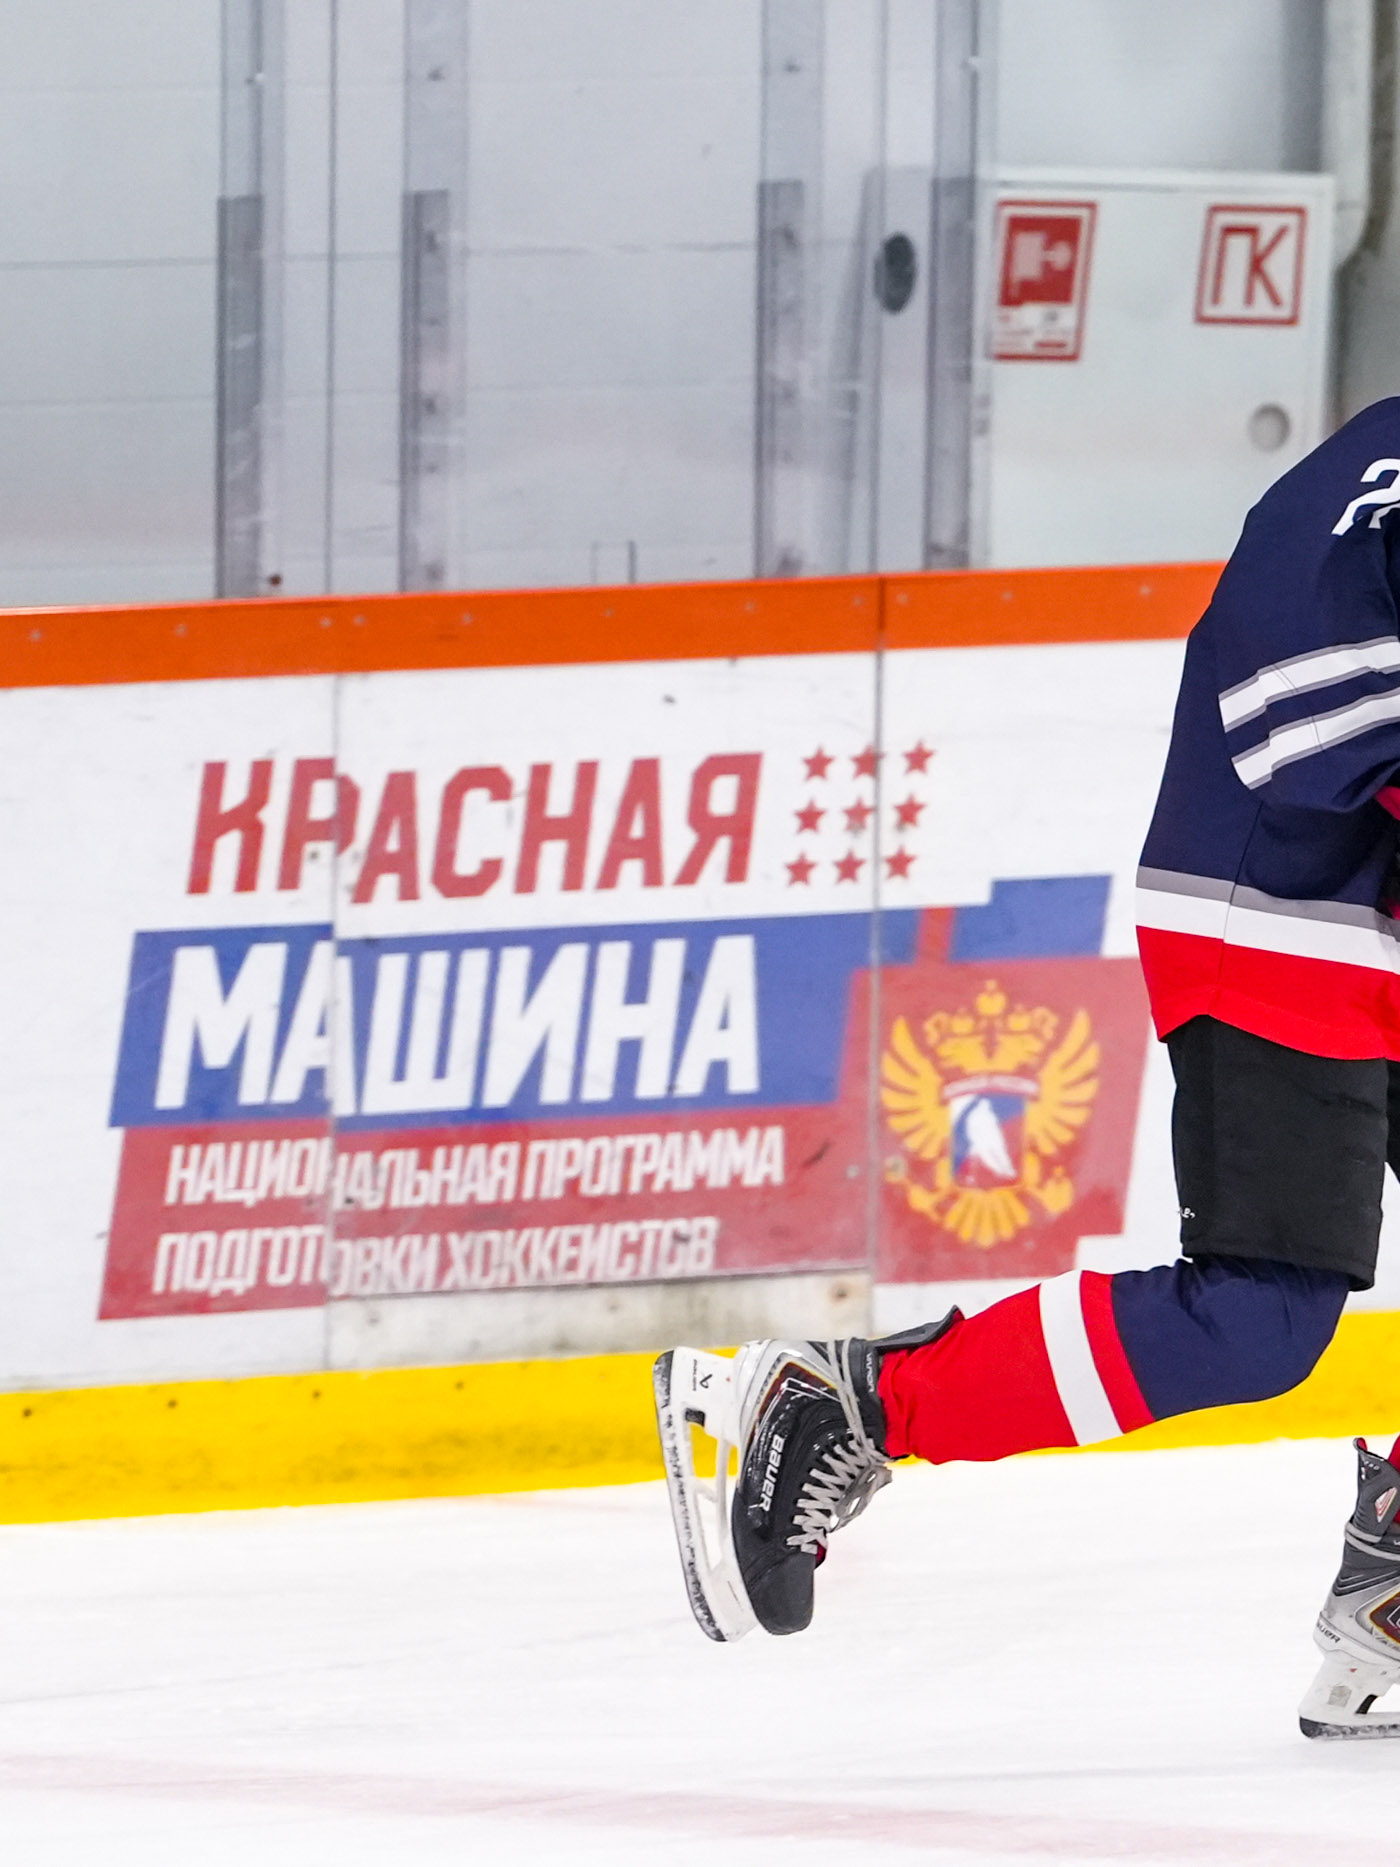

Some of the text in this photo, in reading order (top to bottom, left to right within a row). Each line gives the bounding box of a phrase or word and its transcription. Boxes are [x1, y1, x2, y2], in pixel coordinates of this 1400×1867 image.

[1211, 223, 1291, 307] ПК
[186, 752, 765, 904] КРАСНАЯ
[154, 934, 760, 1116] МАШИНА
[165, 1125, 785, 1211] НАЦИОНАЛЬНАЯ ПРОГРАММА
[153, 1216, 720, 1297] ПОДГОТОВКИ ХОККЕИСТОВ
